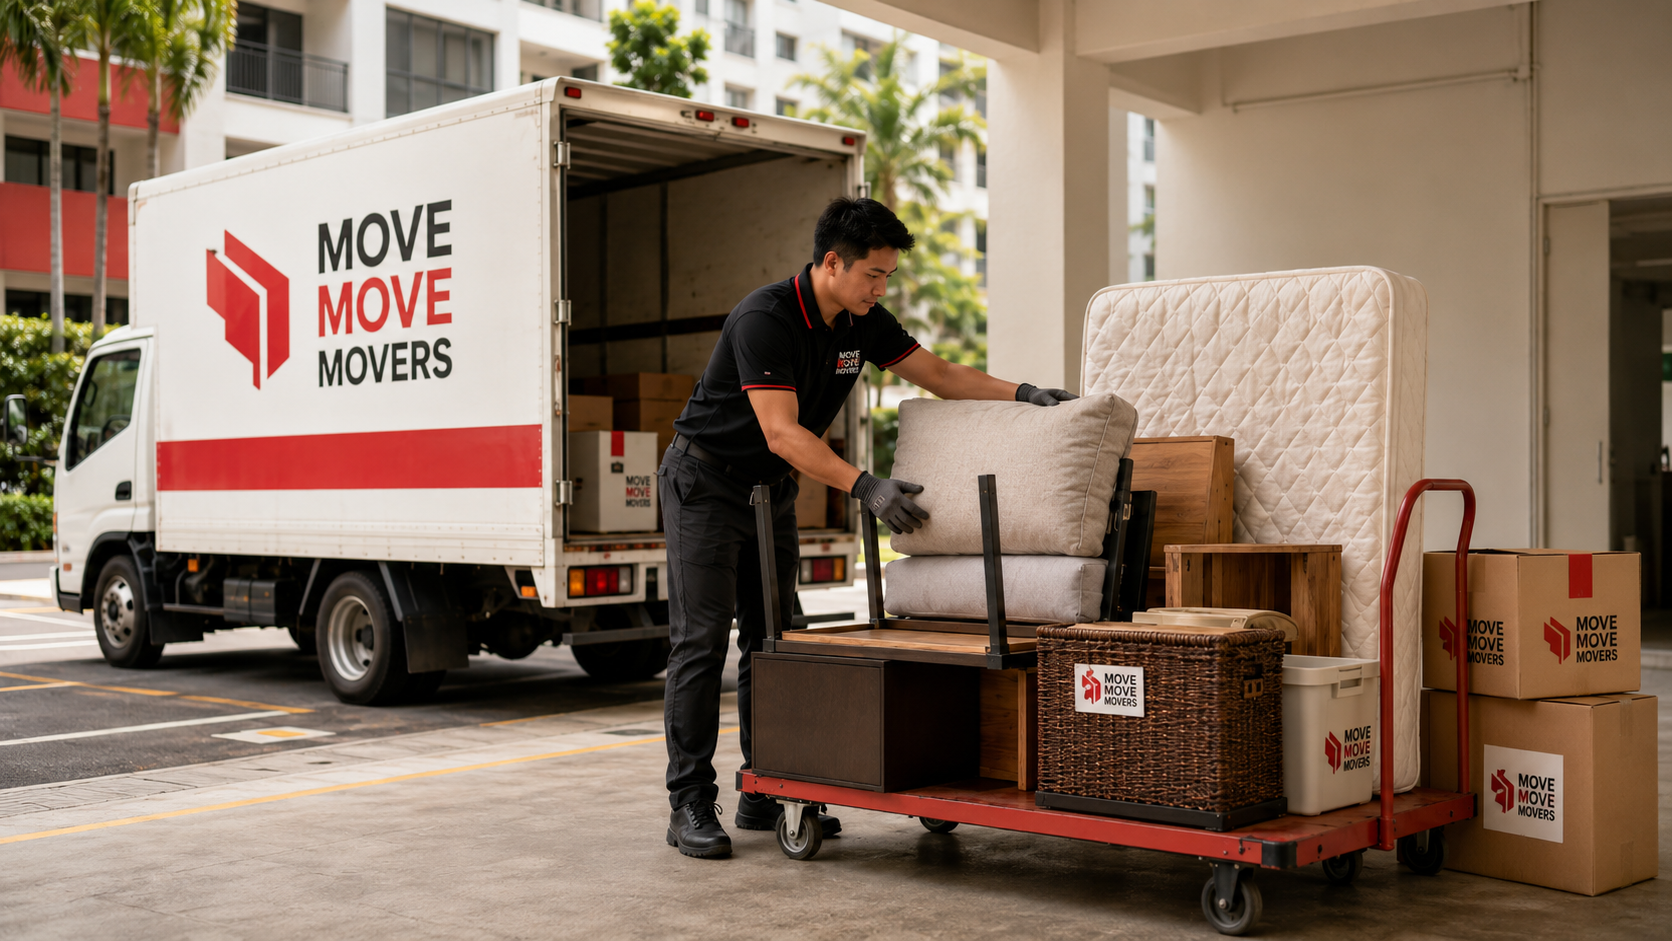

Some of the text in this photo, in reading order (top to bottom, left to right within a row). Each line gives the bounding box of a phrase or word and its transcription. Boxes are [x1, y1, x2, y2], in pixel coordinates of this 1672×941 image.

[318, 199, 452, 274] MOVE
[318, 267, 452, 337] MOVE
[318, 337, 453, 387] MOVERS
[626, 475, 651, 486] MOVE
[626, 487, 651, 498] MOVE
[1467, 619, 1504, 636] MOVE
[1576, 615, 1618, 632] MOVE
[1467, 635, 1504, 652] MOVE
[1576, 632, 1618, 648] MOVE
[1467, 651, 1504, 666] MOVERS
[1576, 649, 1618, 663] MOVERS
[1104, 673, 1137, 685] MOVE
[1104, 685, 1137, 697] MOVE
[1104, 696, 1137, 707] MOVERS
[1344, 725, 1371, 743] MOVE
[1344, 740, 1370, 759] MOVE
[1518, 773, 1555, 792] MOVE
[1518, 789, 1555, 808] MOVE
[1518, 805, 1555, 821] MOVERS
